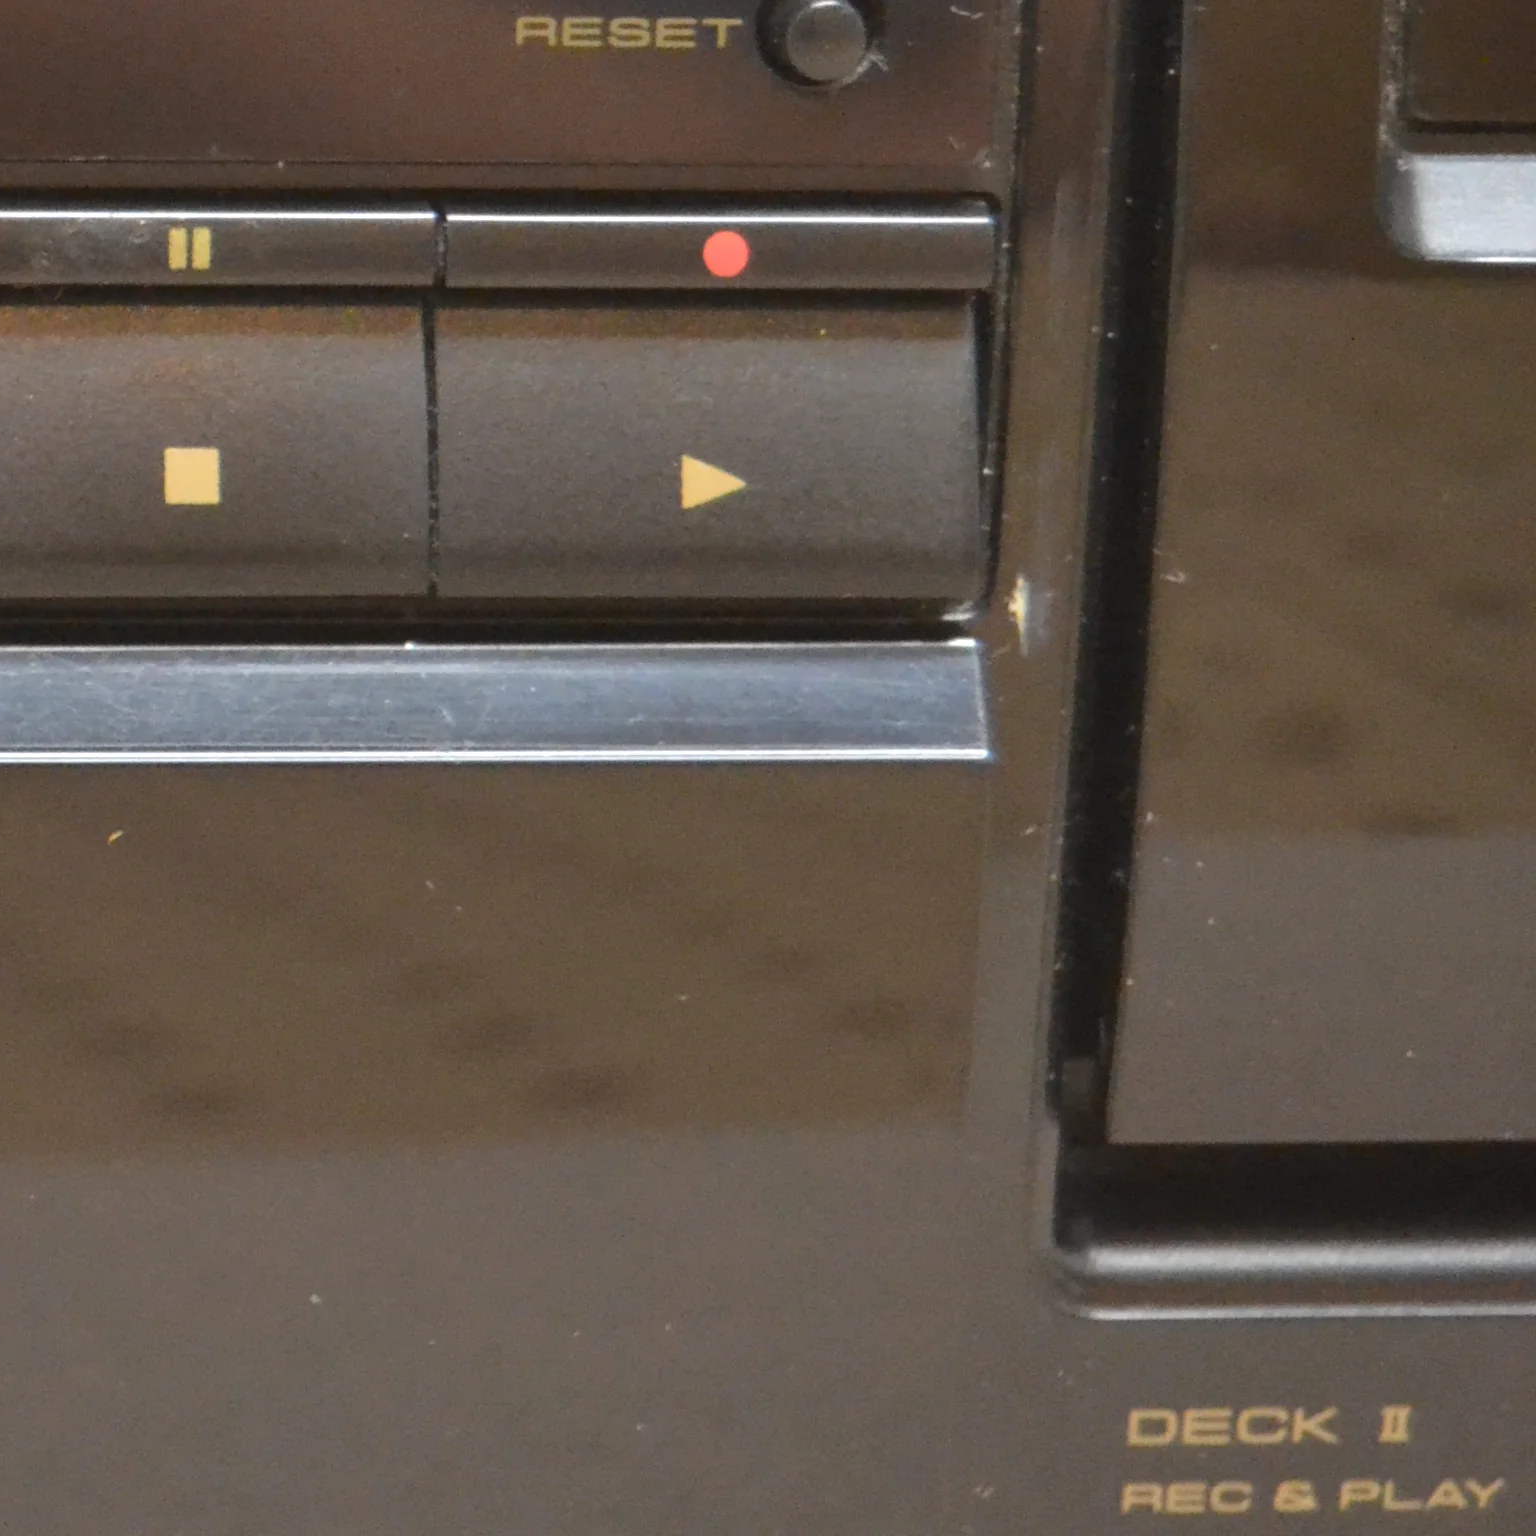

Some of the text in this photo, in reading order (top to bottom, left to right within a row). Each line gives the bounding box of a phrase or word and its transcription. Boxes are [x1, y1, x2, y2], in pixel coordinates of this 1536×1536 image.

[515, 17, 744, 50] RESET
[1128, 1406, 1339, 1446] DECK
[1120, 1476, 1507, 1515] REC & PLAY
